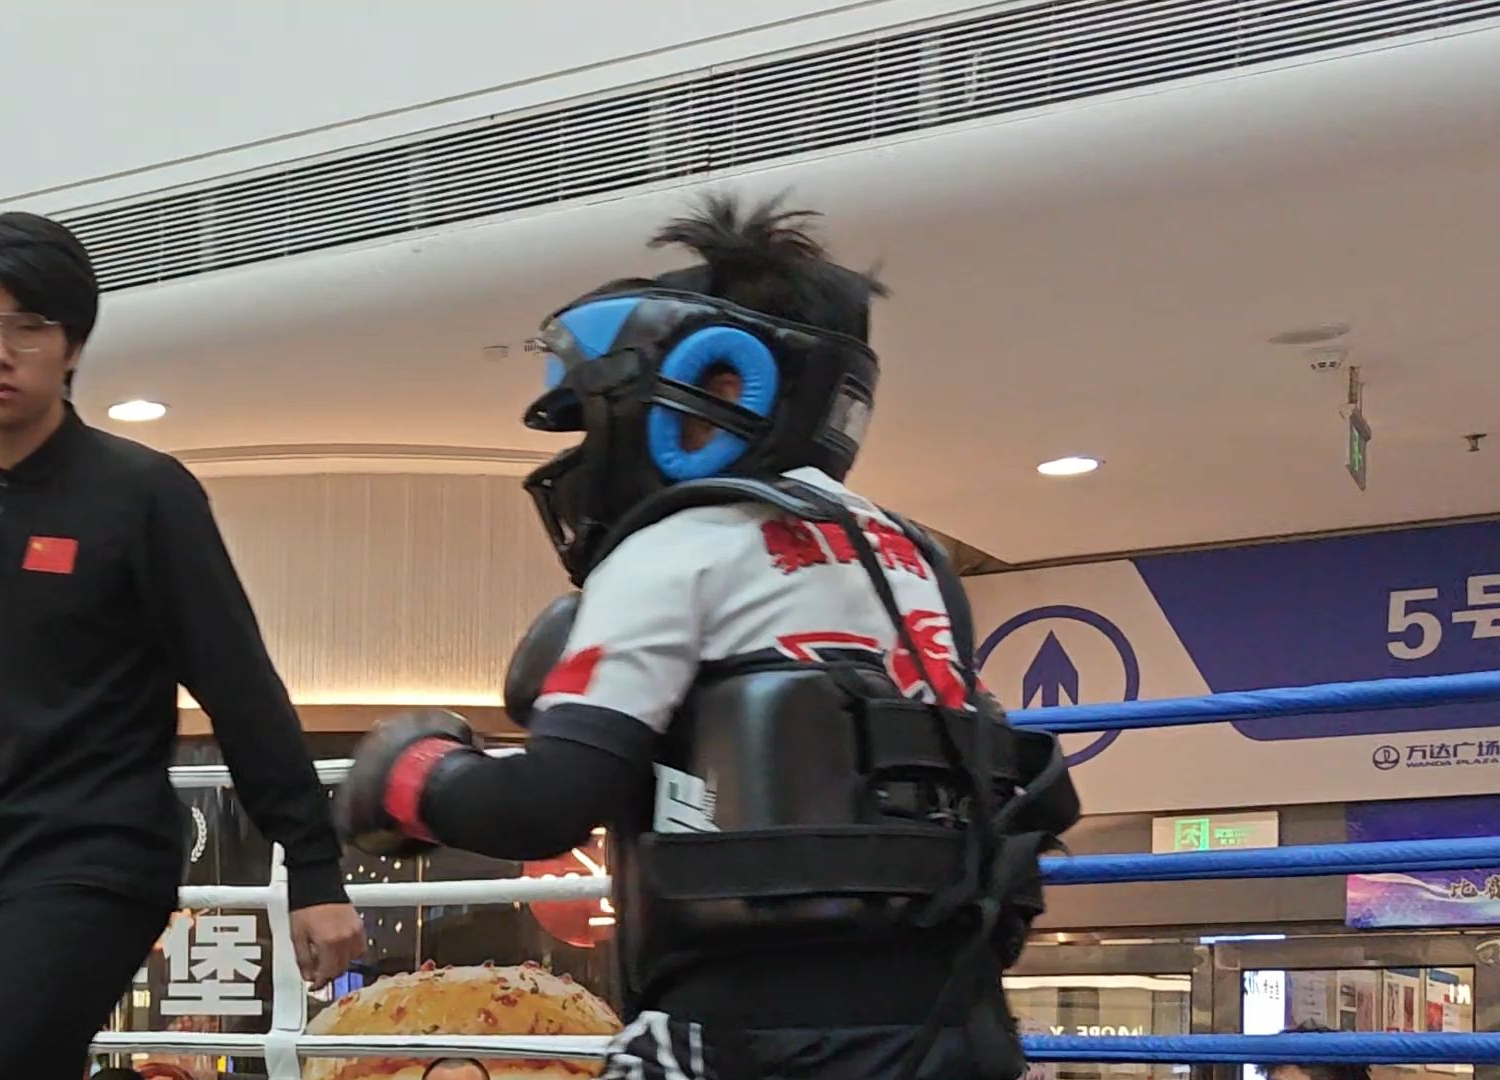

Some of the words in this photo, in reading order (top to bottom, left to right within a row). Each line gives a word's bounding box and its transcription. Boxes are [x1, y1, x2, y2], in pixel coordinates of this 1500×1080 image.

[1406, 741, 1500, 760] 万达广场
[1406, 760, 1451, 769] WANDA
